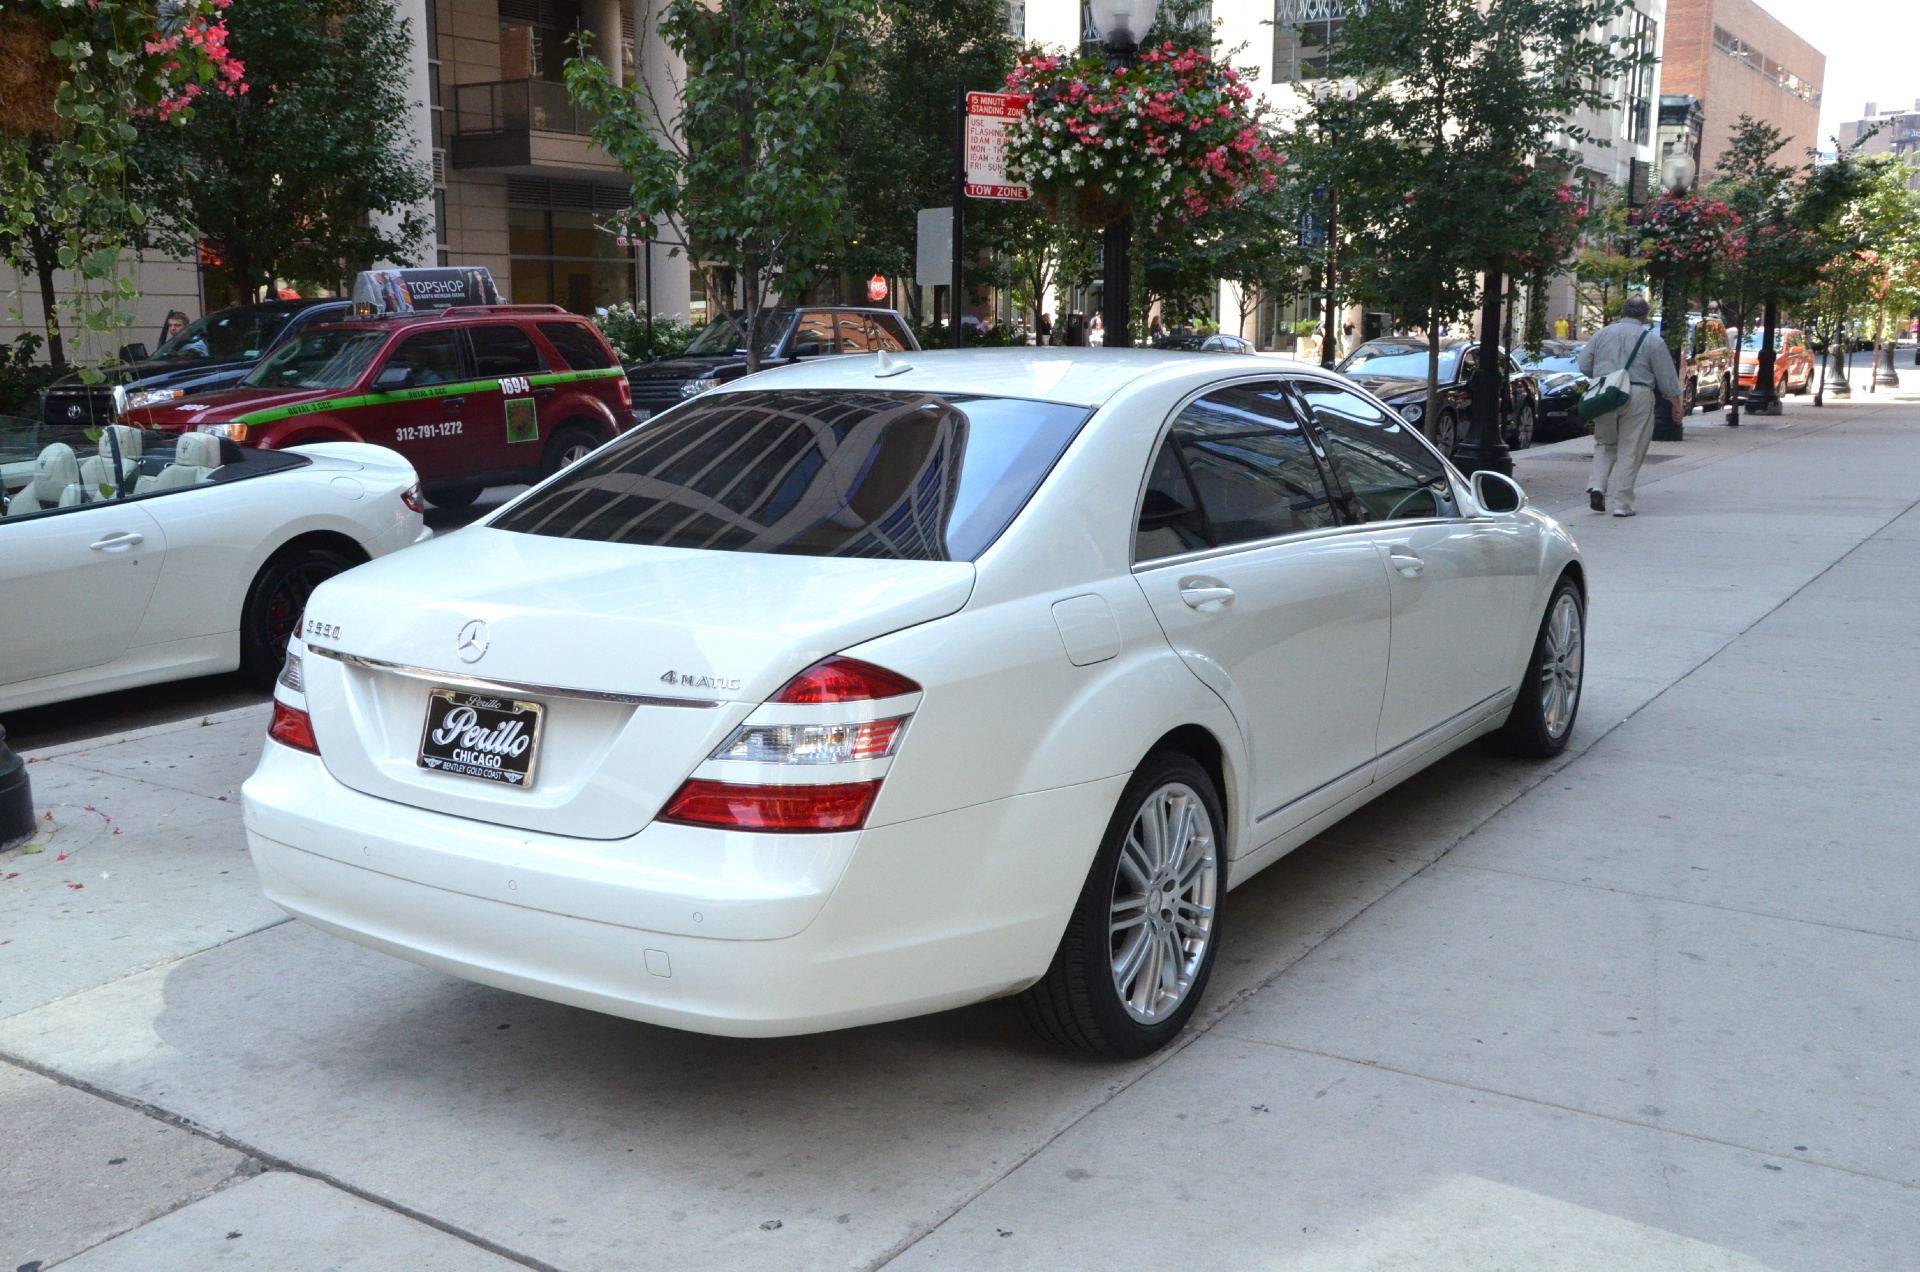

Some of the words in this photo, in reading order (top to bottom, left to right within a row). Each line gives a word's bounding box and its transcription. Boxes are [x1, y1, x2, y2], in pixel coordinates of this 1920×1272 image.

[971, 96, 979, 104] 15
[980, 97, 1005, 107] MINUTE
[971, 105, 1004, 115] STANDING
[1007, 107, 1025, 117] ZONE
[970, 145, 986, 153] MON
[970, 185, 992, 195] TOW
[997, 187, 1024, 198] ZONE
[407, 280, 464, 293] TOPSHOP
[498, 376, 530, 395] 1694
[408, 389, 428, 399] ROYAL
[287, 405, 311, 415] ROYAL
[311, 403, 317, 411] 3
[317, 401, 333, 410] CCC
[396, 421, 463, 441] 312-791-1272
[306, 619, 342, 640] S550
[466, 695, 502, 709] Perillo
[432, 706, 530, 758] Perillo
[452, 748, 502, 768] CHICAGO
[442, 761, 467, 773] BENTLEY
[466, 766, 482, 776] GOLD
[483, 769, 502, 780] COAST
